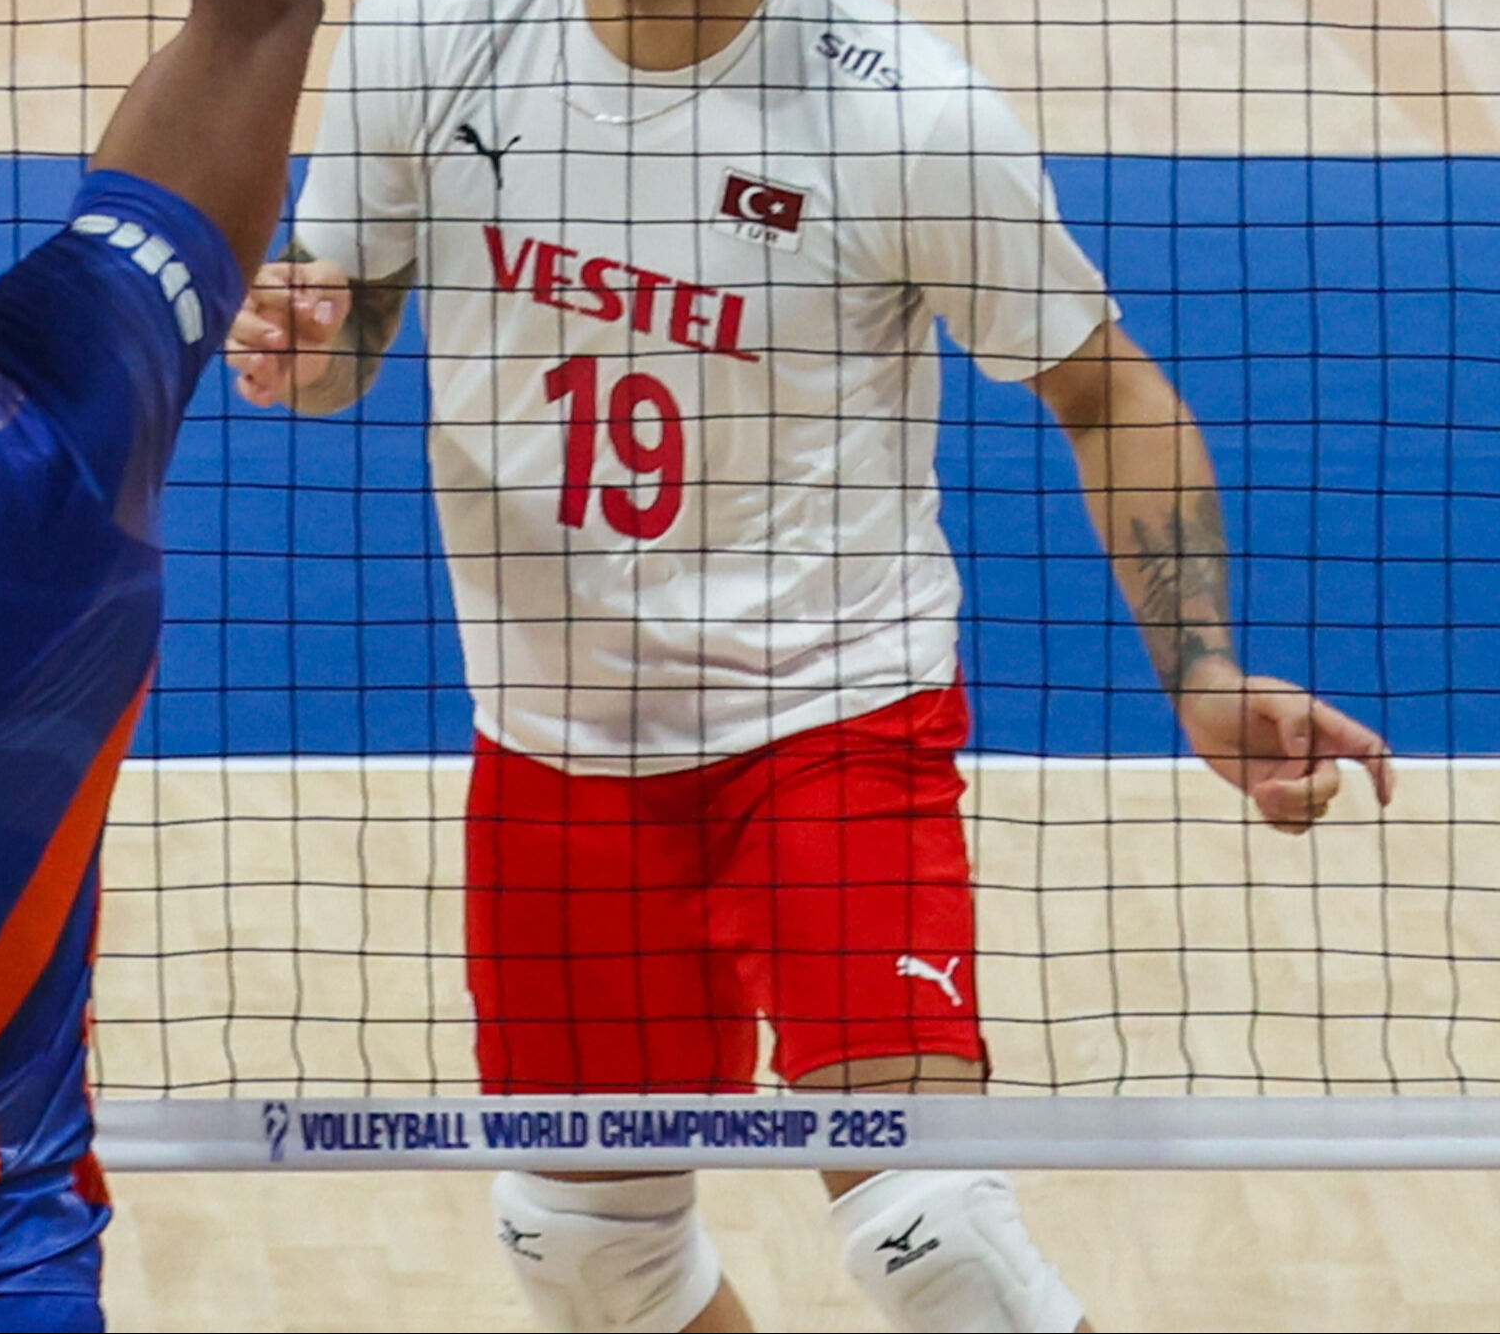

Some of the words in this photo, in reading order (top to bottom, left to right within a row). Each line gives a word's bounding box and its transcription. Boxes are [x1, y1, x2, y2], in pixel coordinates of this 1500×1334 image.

[482, 224, 760, 363] VESTEL
[544, 355, 686, 541] 19
[300, 1112, 471, 1151] VOLLEYBALL
[479, 1111, 589, 1149] WORLD
[599, 1109, 818, 1148] CHAMPIONSHIP
